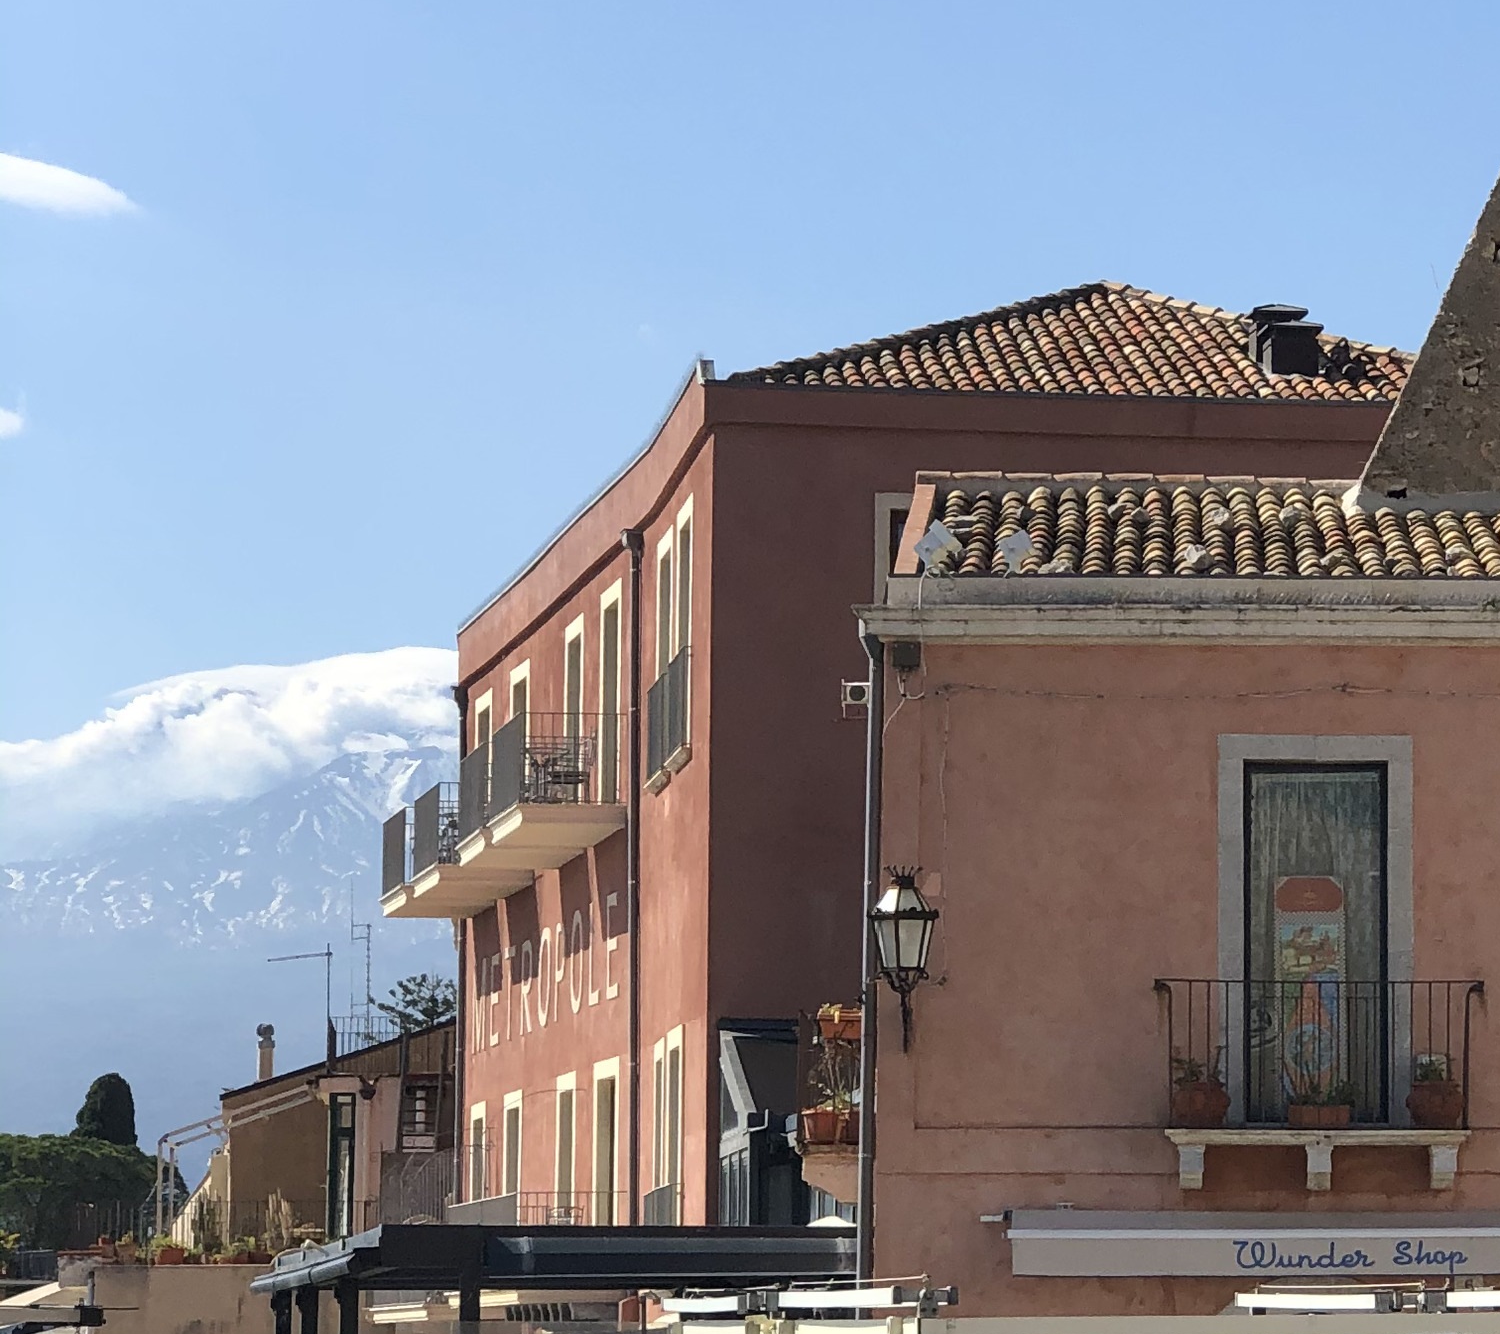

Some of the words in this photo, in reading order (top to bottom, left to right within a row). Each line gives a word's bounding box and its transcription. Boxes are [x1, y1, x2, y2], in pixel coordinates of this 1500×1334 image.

[472, 891, 619, 1055] METROPOLE
[1232, 1240, 1376, 1269] Wunder
[1392, 1239, 1468, 1274] Shop
